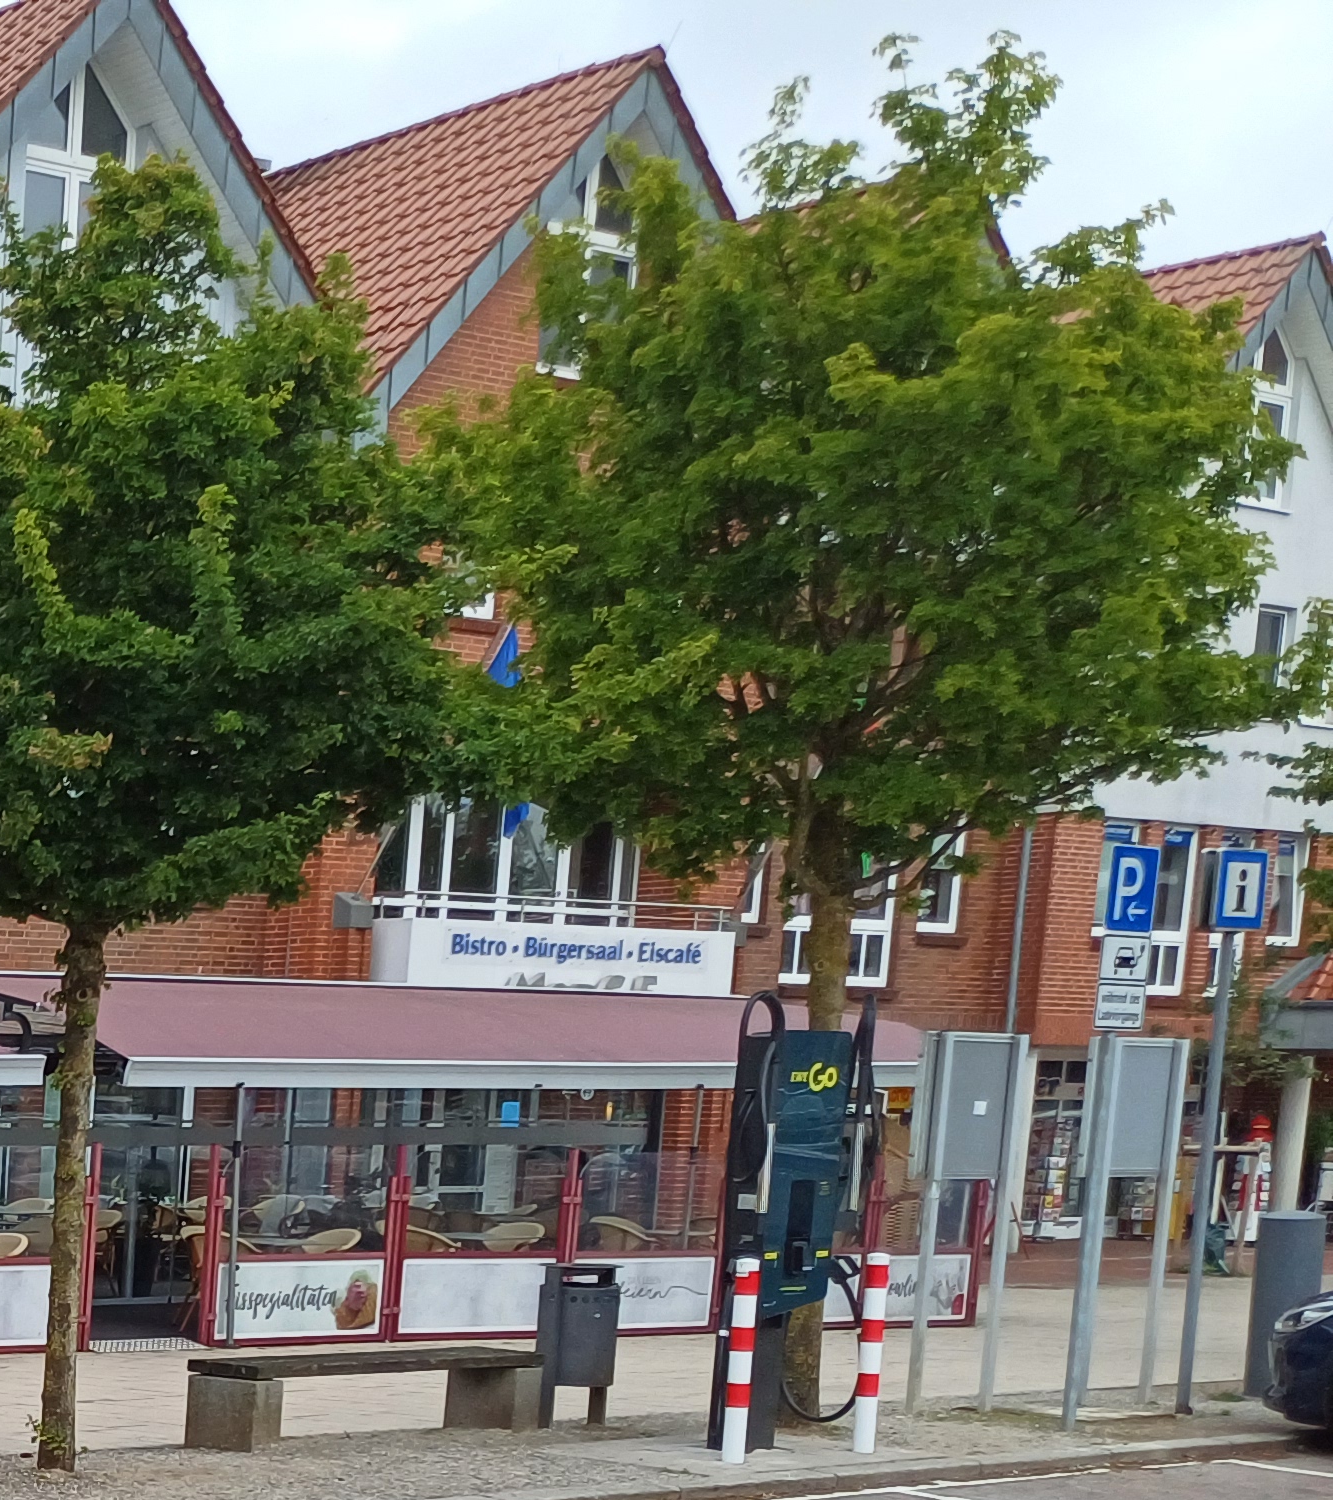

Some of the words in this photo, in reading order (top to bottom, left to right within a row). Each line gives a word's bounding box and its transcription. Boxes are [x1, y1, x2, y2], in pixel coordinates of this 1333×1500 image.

[1113, 857, 1146, 921] P
[450, 932, 508, 957] Bistro
[522, 935, 624, 965] Bürgersaal
[636, 940, 703, 965] Eiscafé
